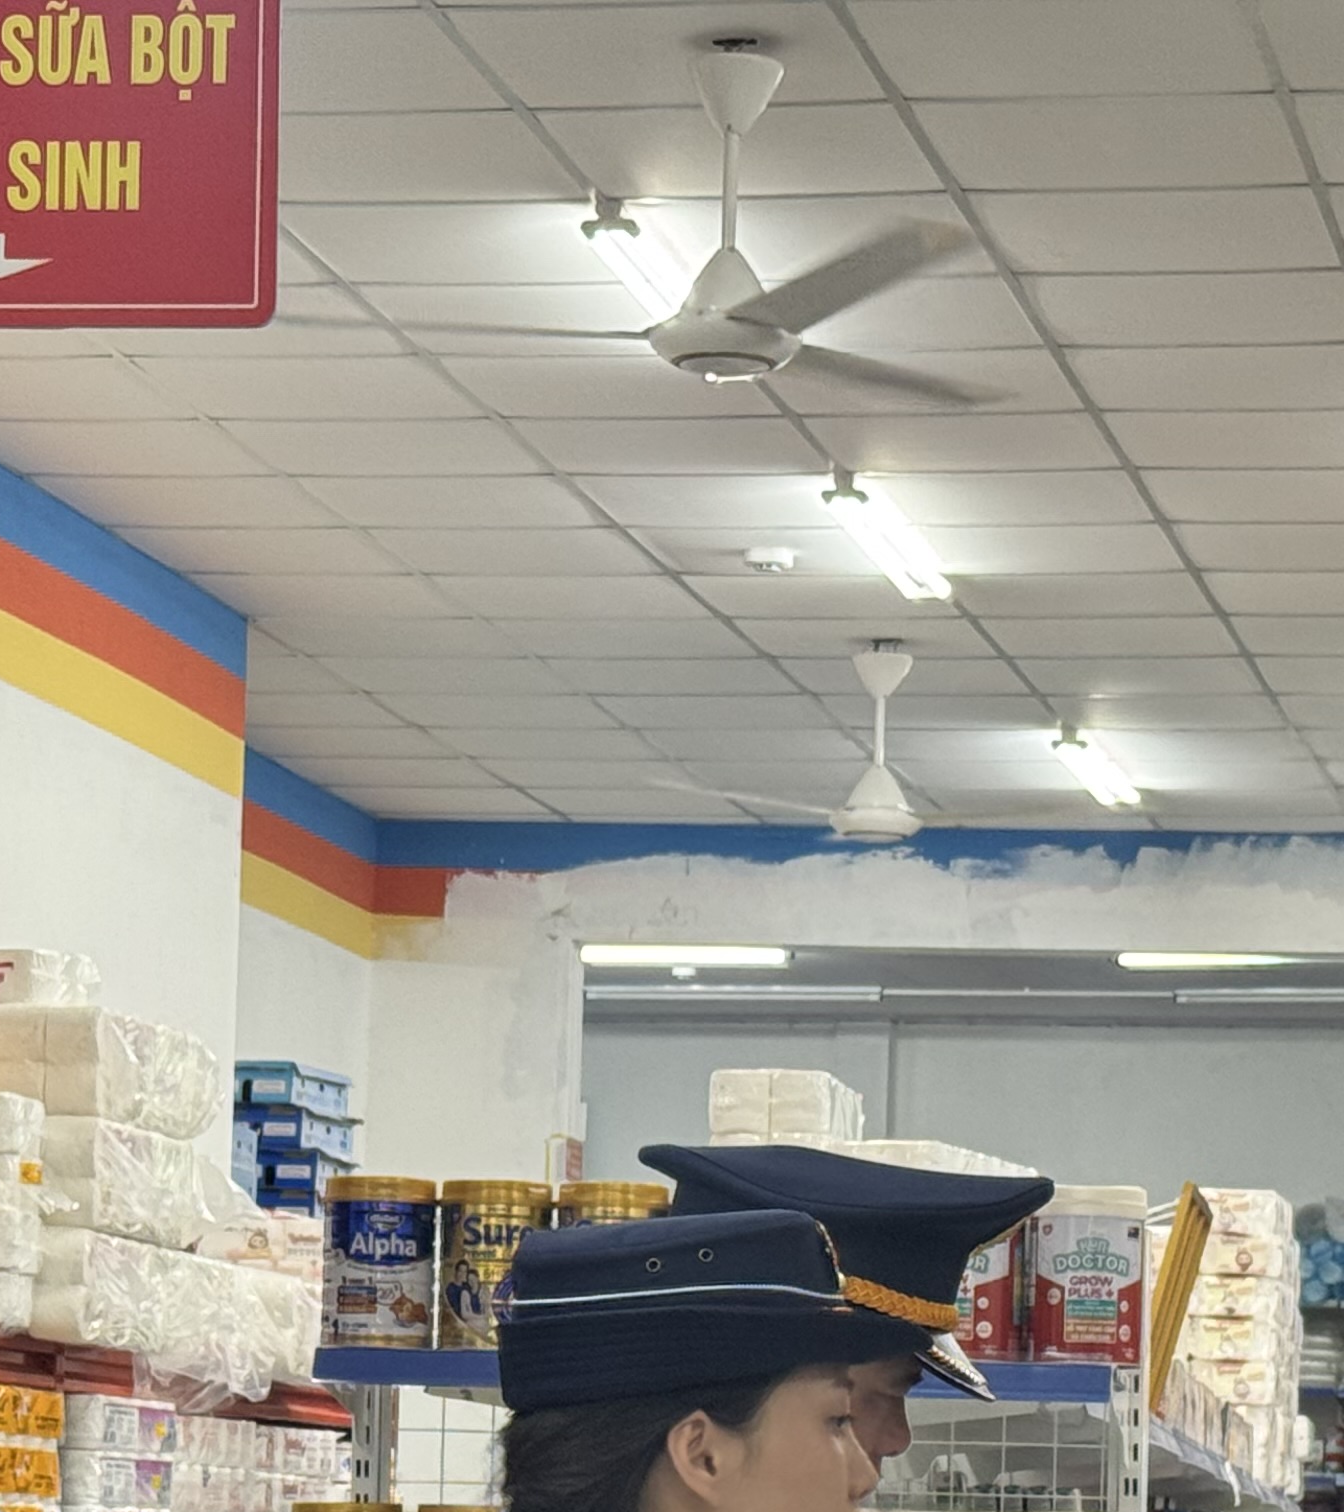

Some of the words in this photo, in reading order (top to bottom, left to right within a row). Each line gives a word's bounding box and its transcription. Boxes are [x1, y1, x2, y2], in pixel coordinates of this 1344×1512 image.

[0, 1, 112, 86] SỮA
[131, 0, 236, 101] BỘT
[7, 140, 142, 212] SINH
[349, 1232, 417, 1260] Alpha
[1055, 1254, 1129, 1277] DOCTOR
[1068, 1287, 1103, 1299] PLUS
[1069, 1275, 1114, 1287] GROW
